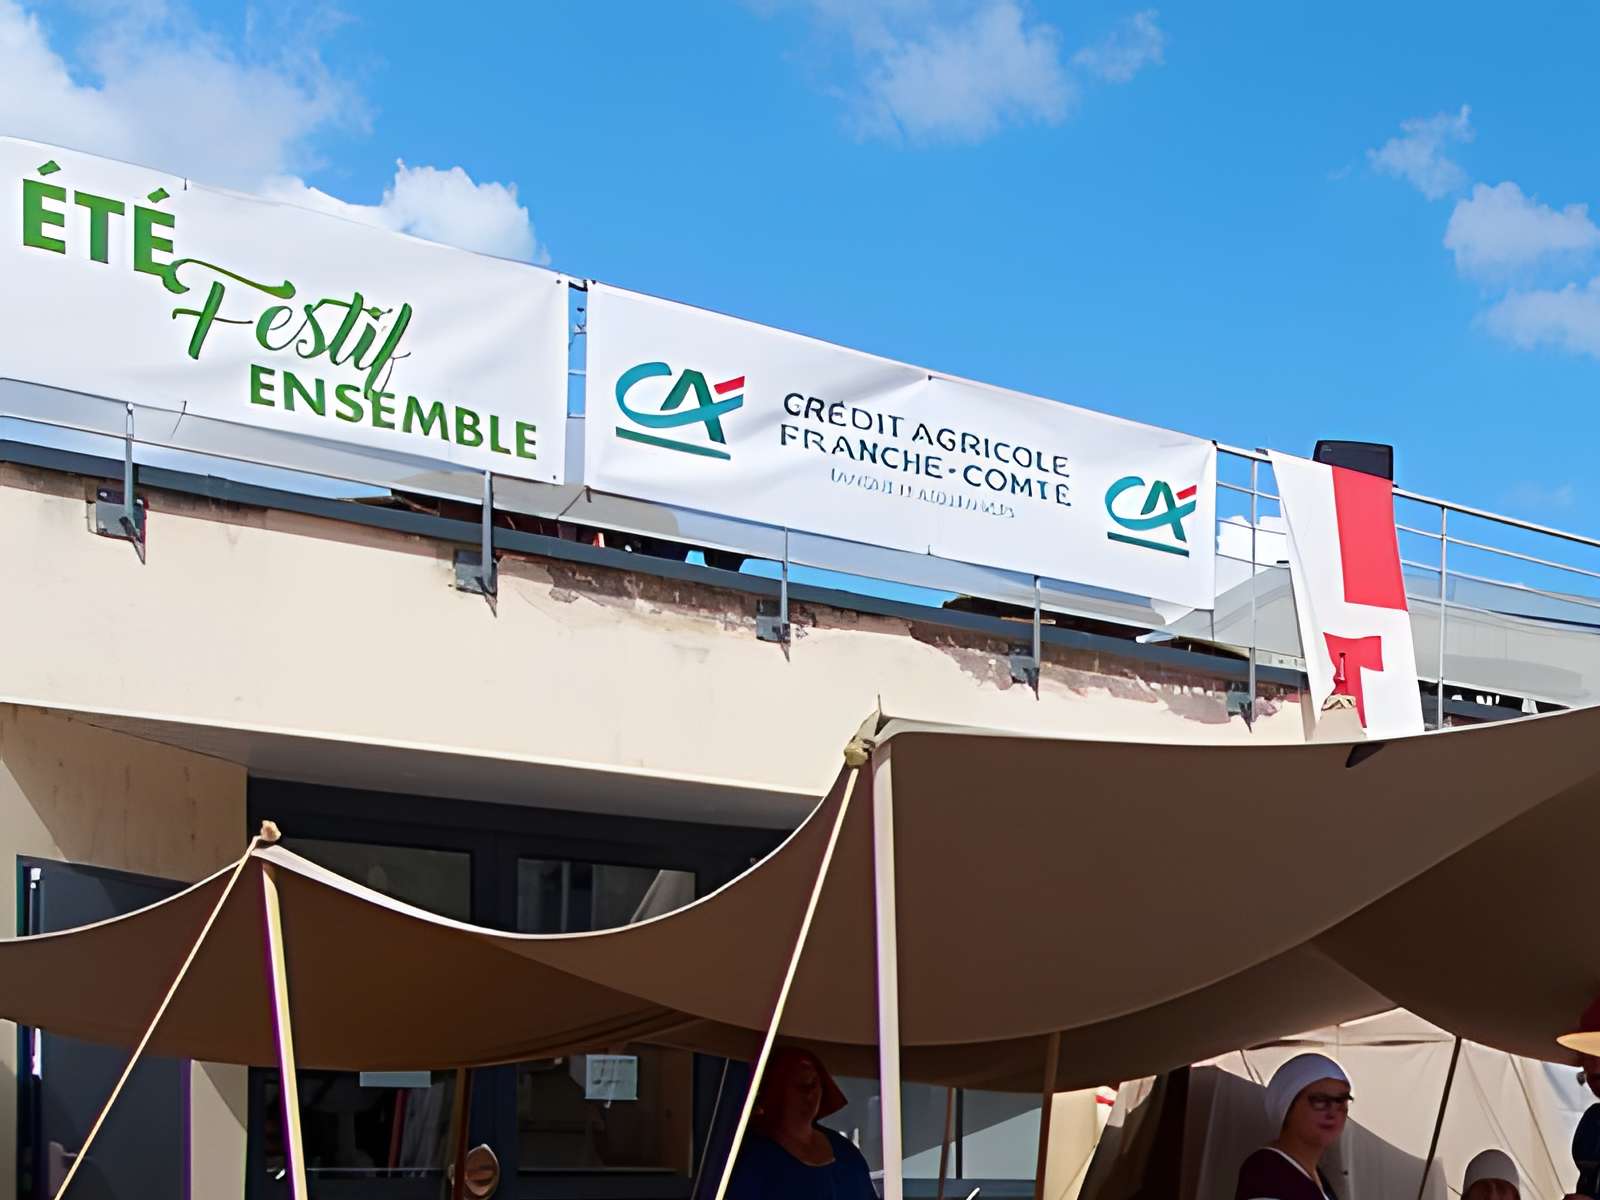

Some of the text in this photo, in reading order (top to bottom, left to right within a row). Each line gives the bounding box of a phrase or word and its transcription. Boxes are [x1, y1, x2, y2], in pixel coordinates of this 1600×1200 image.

[23, 160, 175, 275] ÉTÉ
[161, 258, 412, 400] Festif
[250, 363, 537, 460] ENSEMBLE
[911, 423, 1071, 478] AGRICOLE
